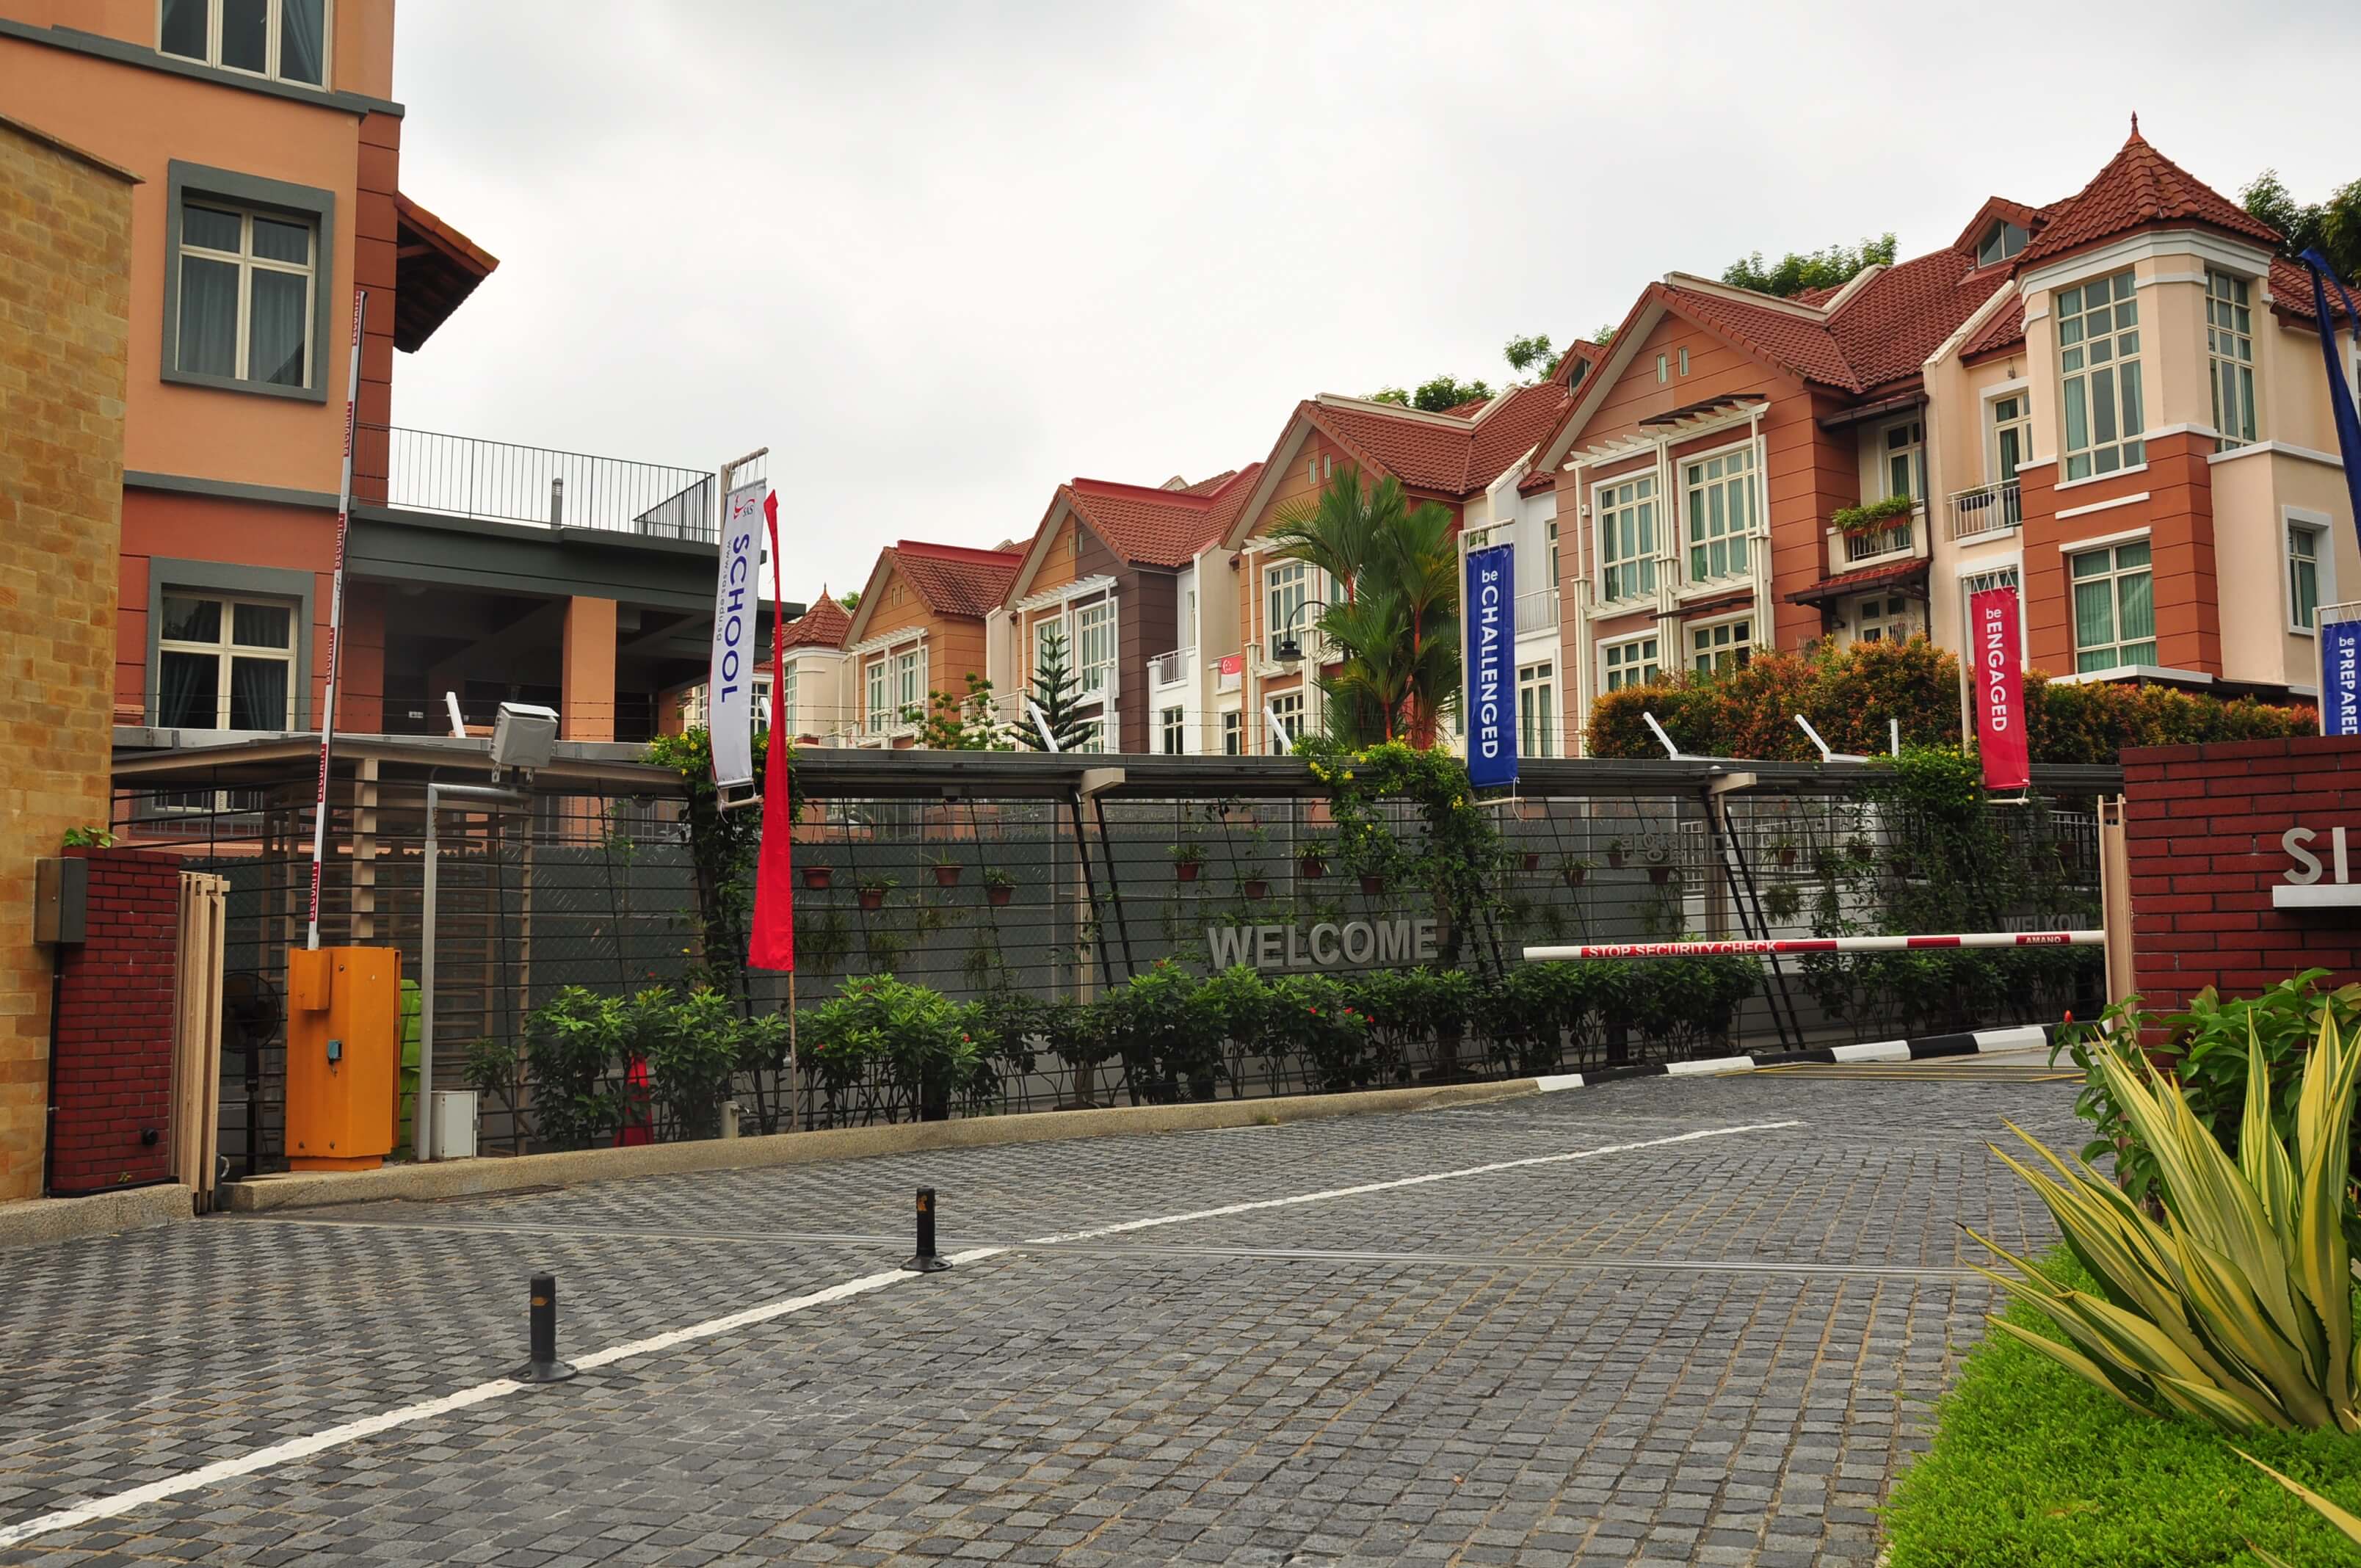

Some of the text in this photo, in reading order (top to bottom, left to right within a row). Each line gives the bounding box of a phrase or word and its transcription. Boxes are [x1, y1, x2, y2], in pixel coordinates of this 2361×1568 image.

[717, 540, 732, 641] www.sas.edu.sg
[722, 534, 750, 703] SCHOOL
[1481, 569, 1498, 758] be CHALLENGED
[1986, 608, 2007, 732] be ENGAGED
[2339, 636, 2355, 647] be
[2282, 827, 2349, 885] SI
[1208, 918, 1438, 970] WELCOME
[1589, 941, 1776, 957] STOP SECURITY CHECK
[2025, 936, 2061, 944] AMANO
